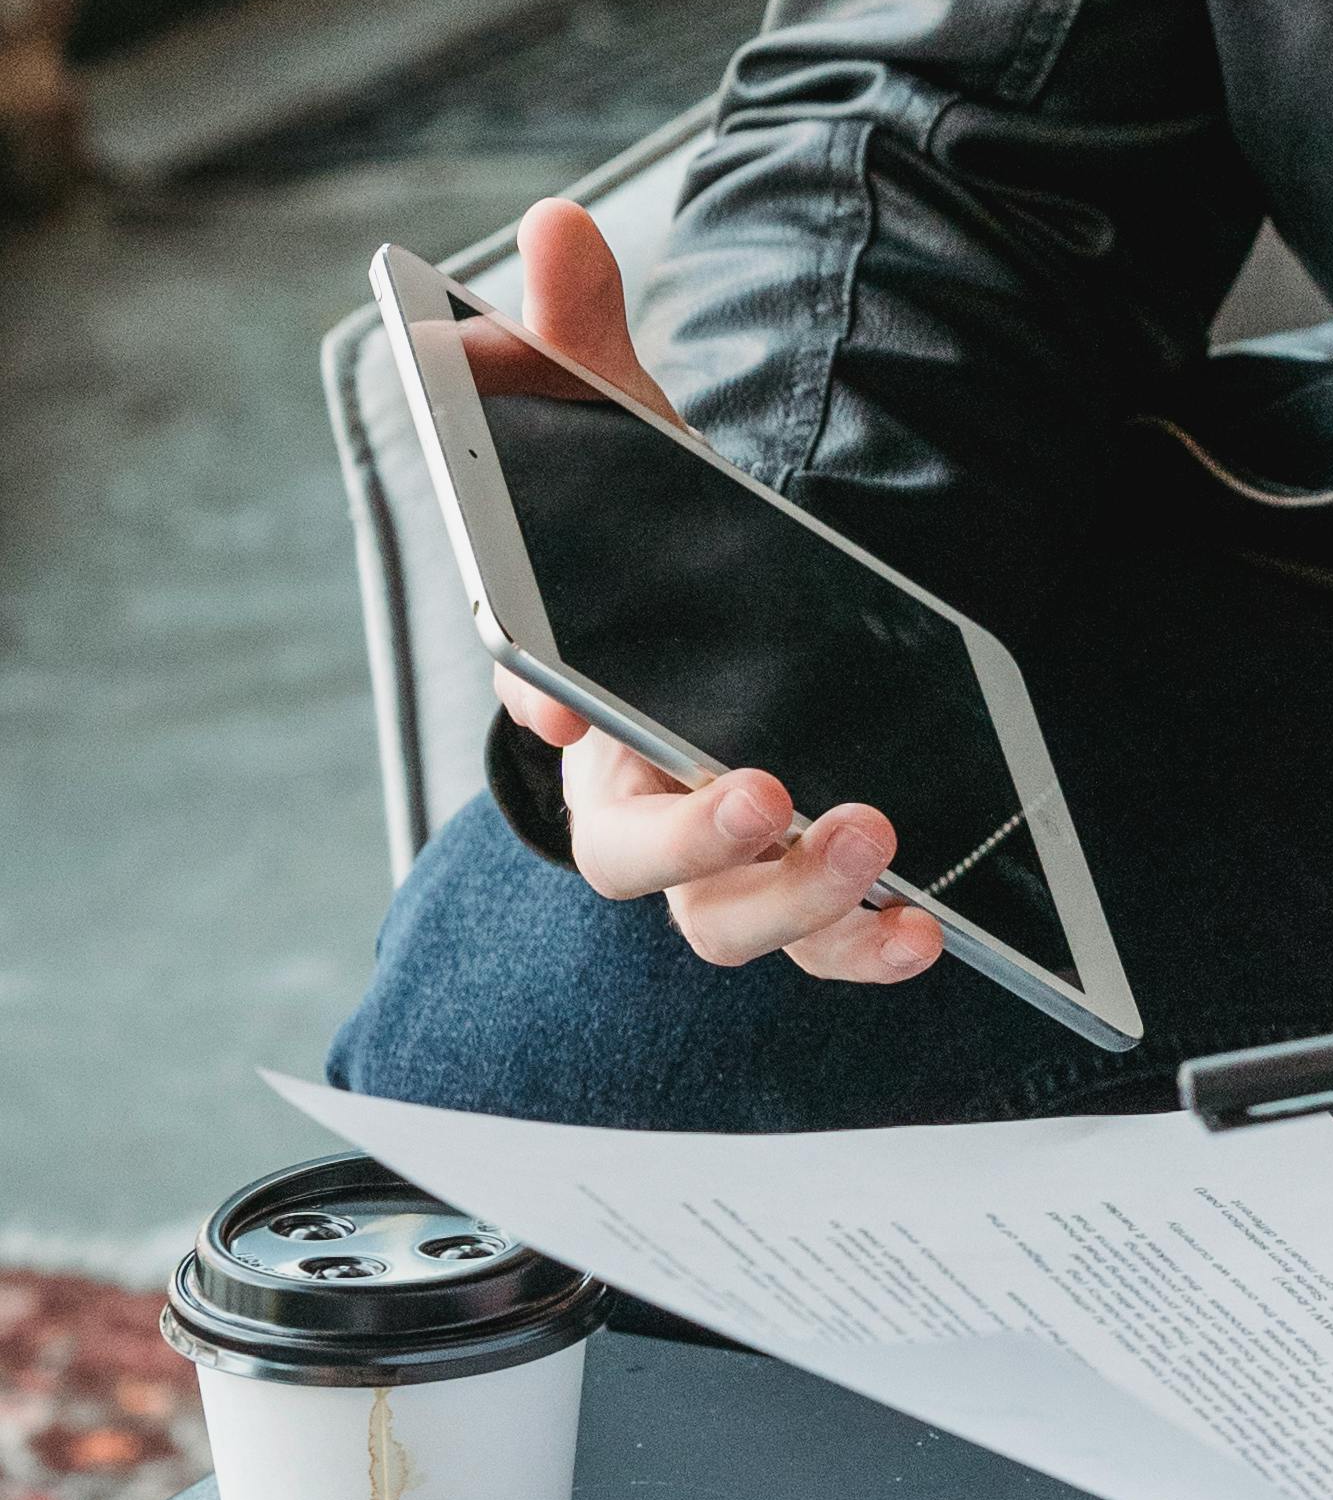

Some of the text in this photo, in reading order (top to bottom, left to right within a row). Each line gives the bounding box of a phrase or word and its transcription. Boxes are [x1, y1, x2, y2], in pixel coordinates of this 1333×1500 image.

[1191, 1185, 1227, 1208] part)
[1219, 1208, 1272, 1250] selection
[1228, 1198, 1278, 1237] different
[1144, 1241, 1183, 1273] makes
[1267, 1251, 1296, 1273] from
[1283, 1246, 1318, 1272] mean
[1292, 1273, 1329, 1302] Starts
[1255, 1302, 1277, 1318] the
